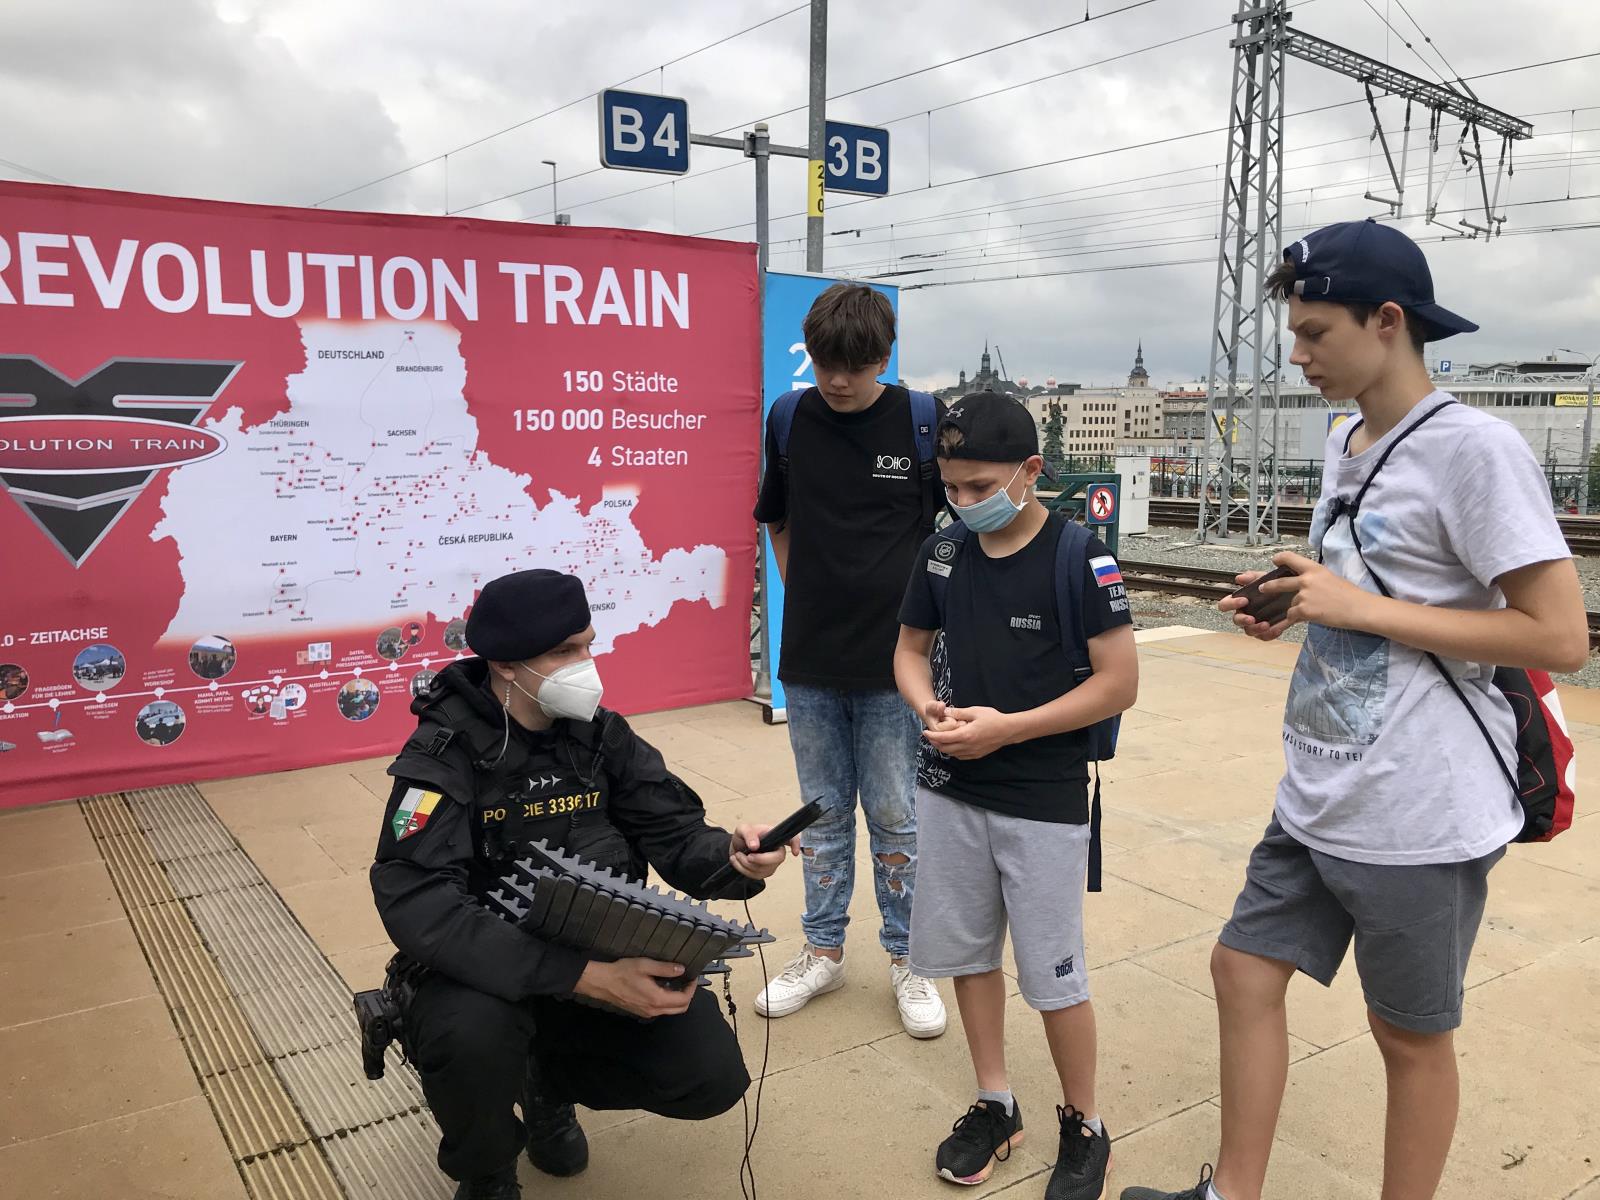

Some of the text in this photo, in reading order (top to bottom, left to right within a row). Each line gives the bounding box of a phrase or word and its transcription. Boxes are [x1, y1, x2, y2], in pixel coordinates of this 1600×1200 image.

[828, 136, 882, 181] 3B
[499, 262, 690, 329] TRAIN
[318, 350, 385, 359] DEUTSCHLAND
[563, 370, 678, 393] 150 Städte
[269, 419, 310, 428] THÜRINGEN
[513, 408, 706, 431] 150 000 Besucher
[387, 429, 417, 437] SACHSEN
[130, 439, 205, 450] TRAIN
[587, 446, 688, 467] 4 Staaten
[876, 455, 911, 471] SOHO
[603, 499, 633, 508] POLSKA
[270, 534, 298, 542] BAYERN
[438, 532, 514, 546] ČESKÁ REPUBLIKA
[1010, 616, 1041, 630] RUSSIA
[30, 626, 109, 645] ZEITACHSE
[1298, 742, 1324, 756] STORY
[1329, 750, 1340, 760] TO
